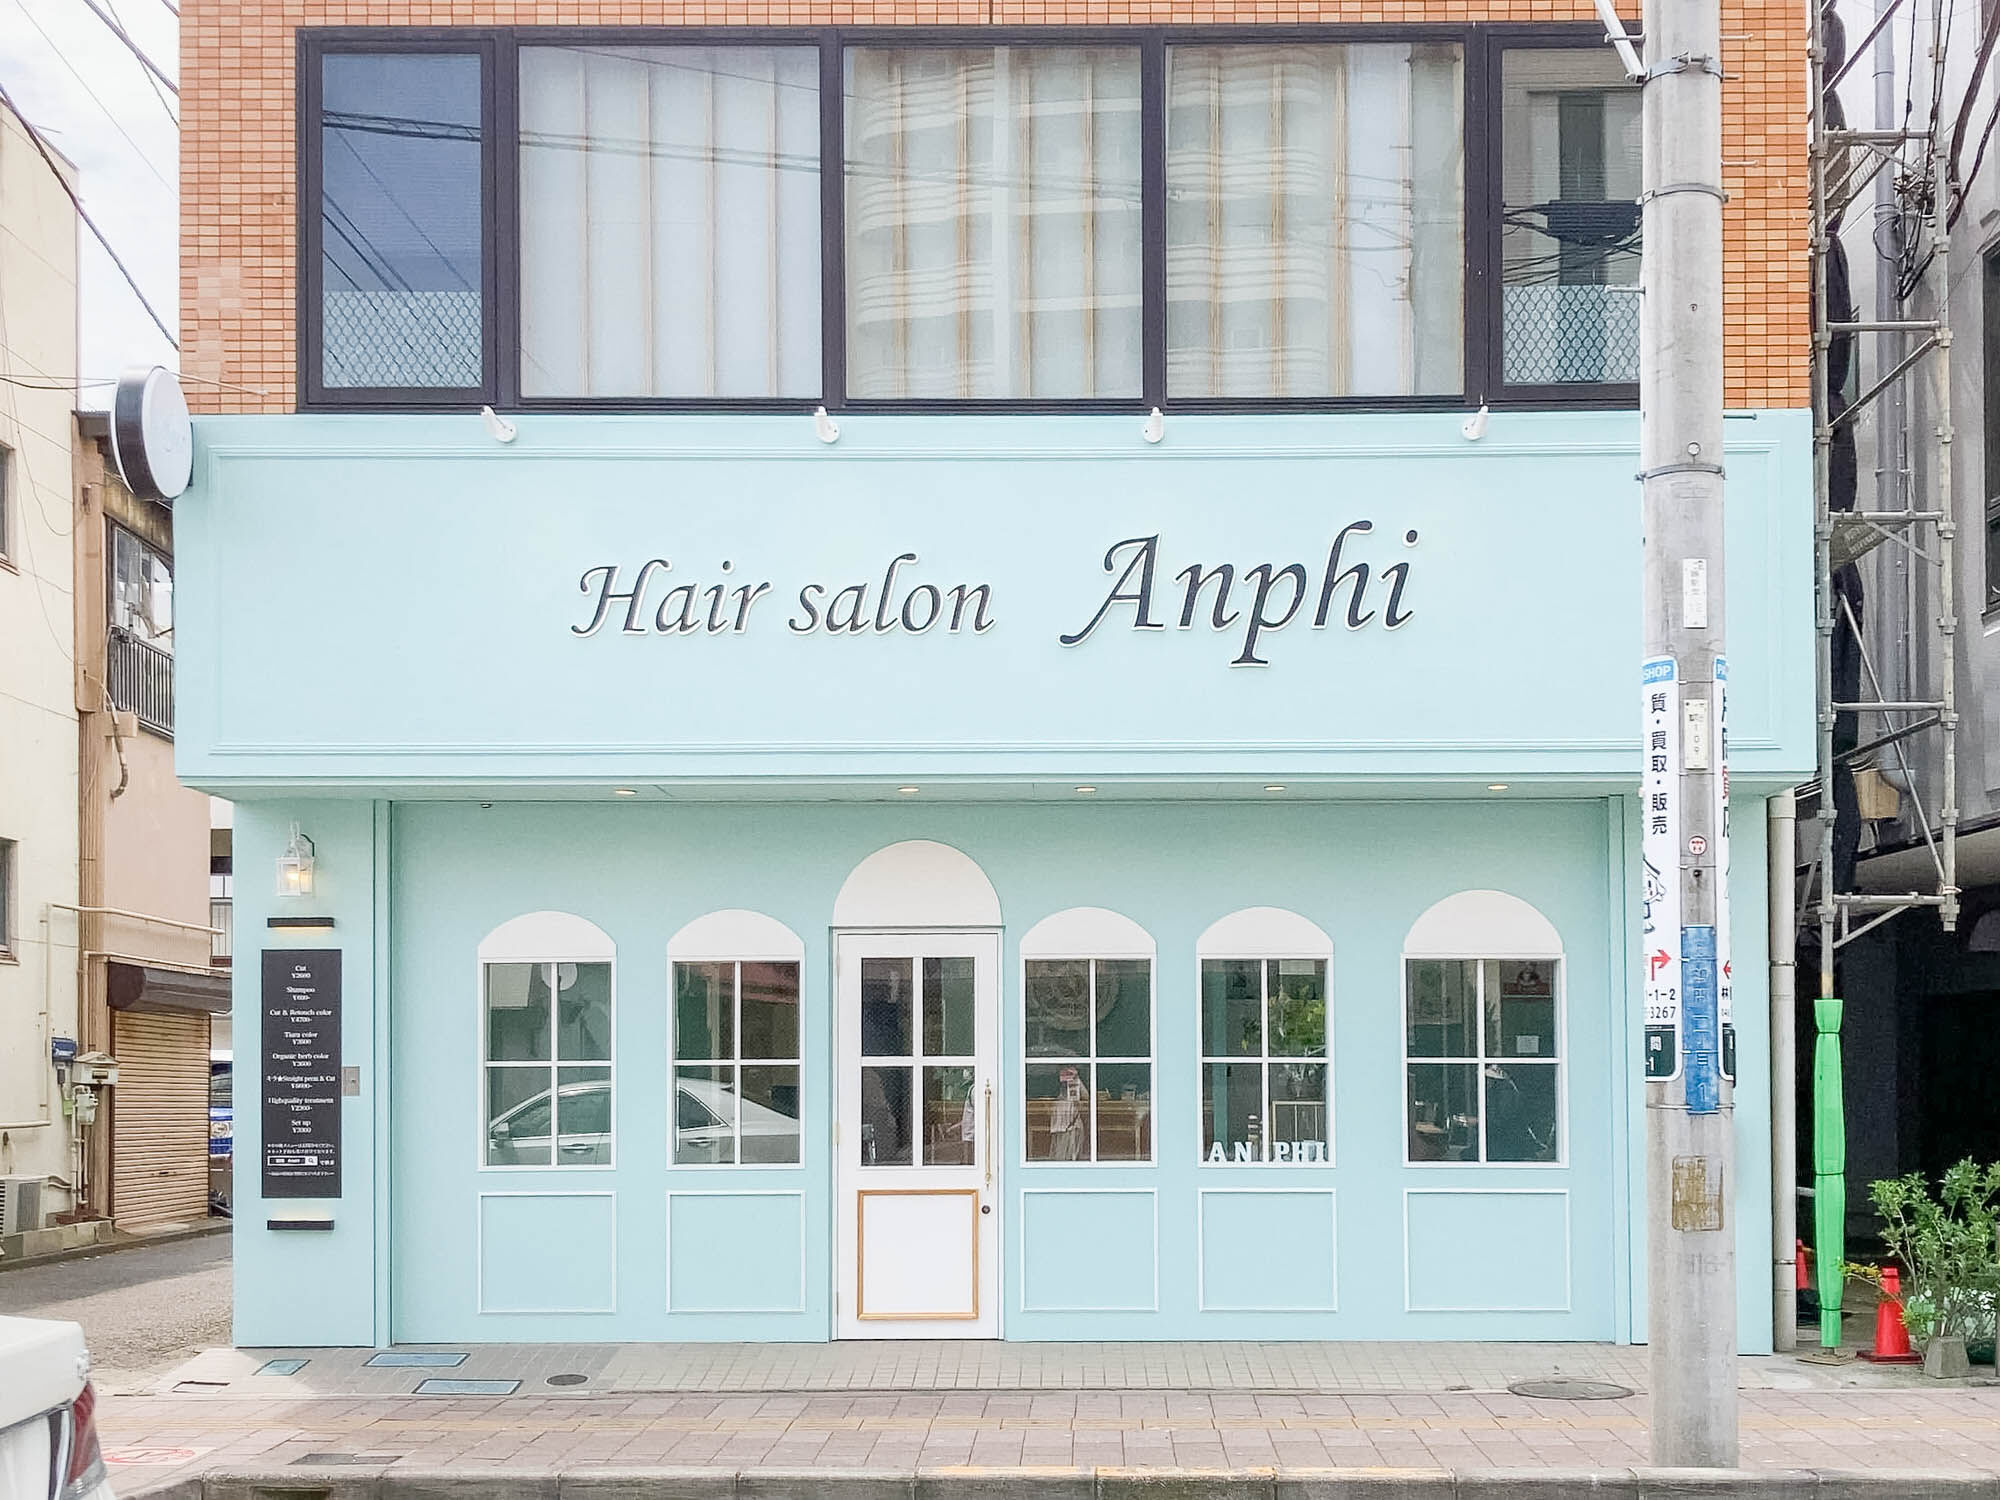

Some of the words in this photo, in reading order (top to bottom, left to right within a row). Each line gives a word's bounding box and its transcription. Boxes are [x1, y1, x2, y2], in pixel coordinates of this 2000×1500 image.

[570, 558, 773, 637] Hair
[788, 552, 996, 636] salon
[1059, 519, 1418, 668] Anphi
[1643, 665, 1671, 679] SHOP
[286, 986, 316, 994] Shampoo
[1645, 988, 1676, 1001] -1-2
